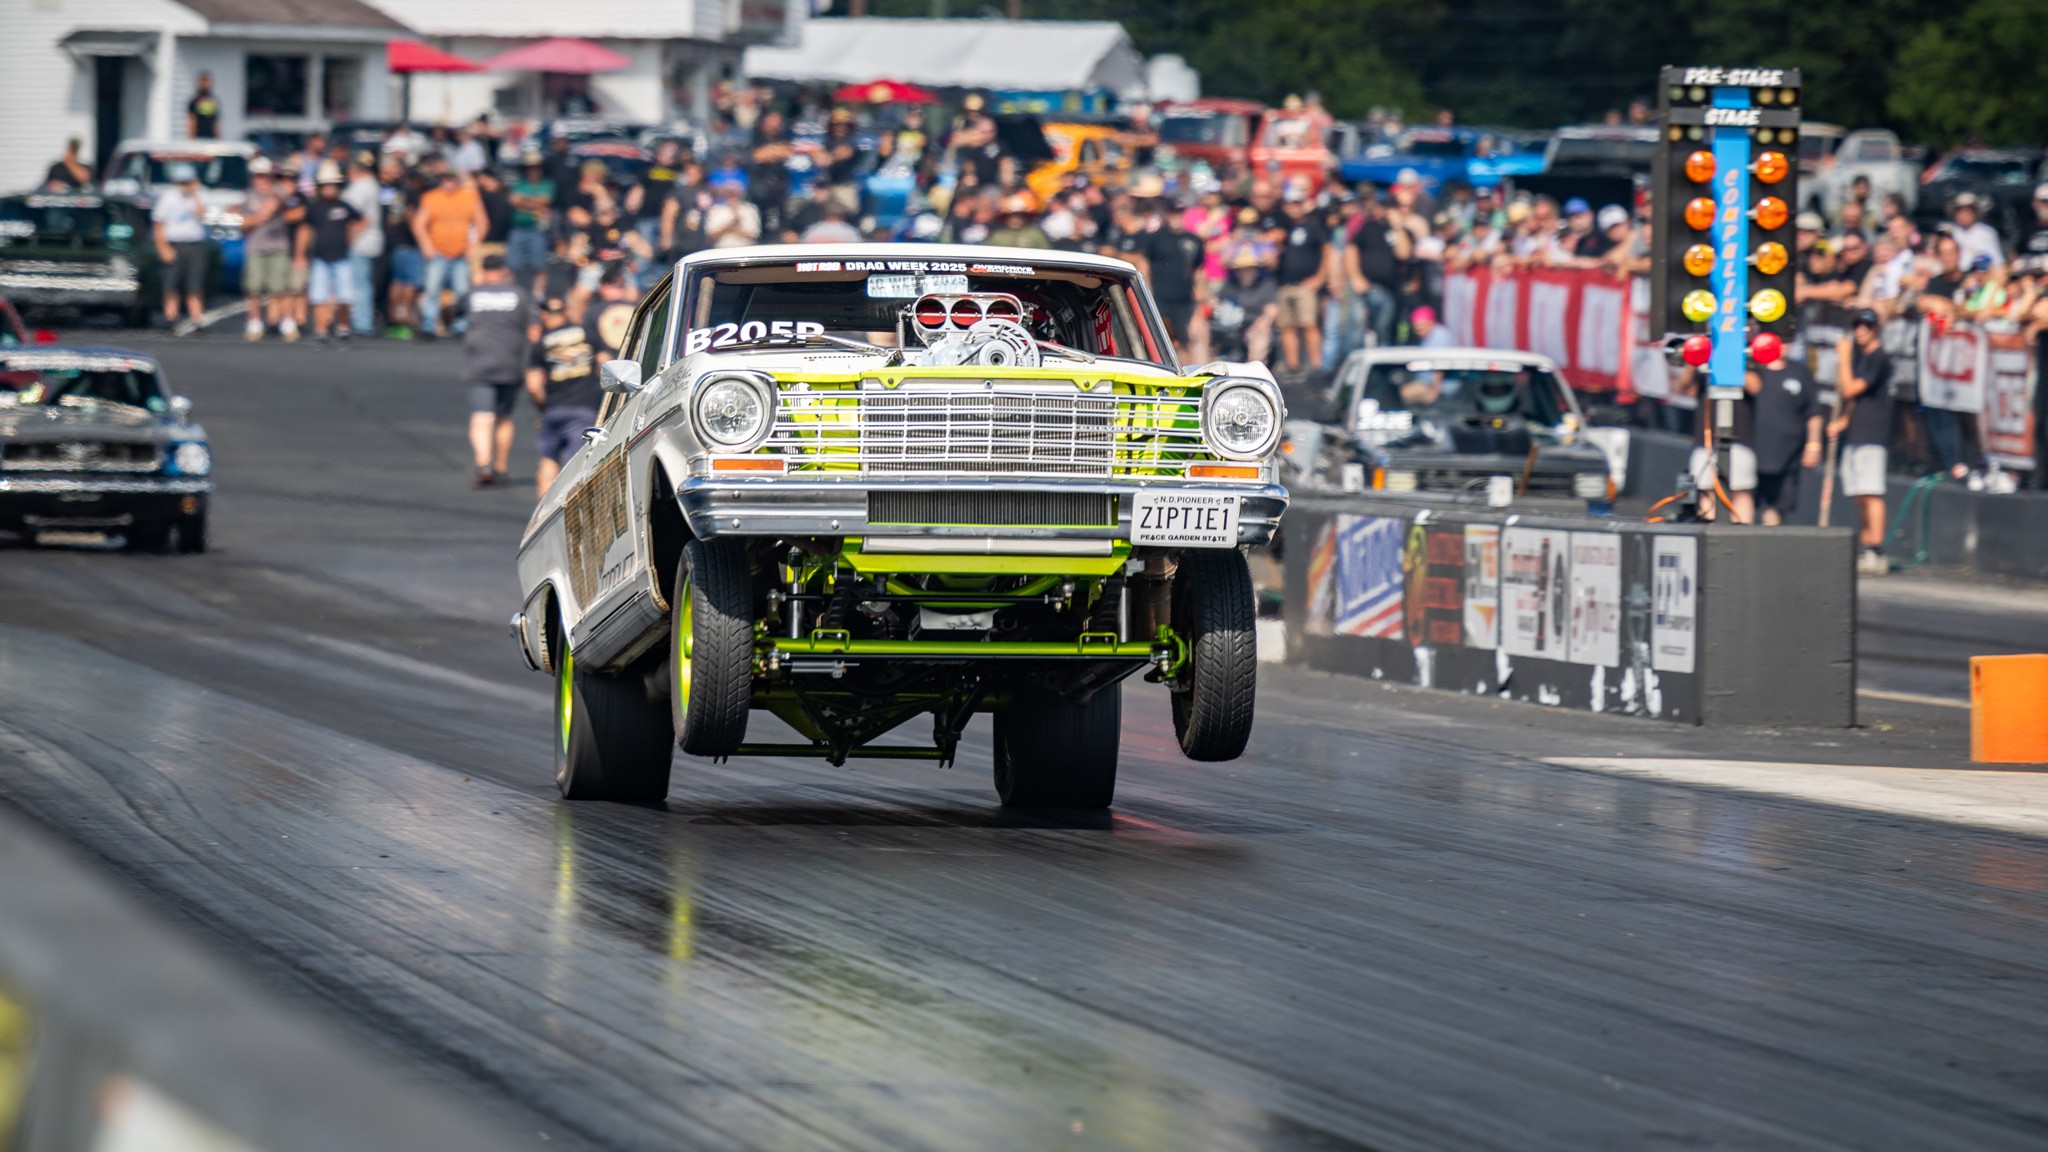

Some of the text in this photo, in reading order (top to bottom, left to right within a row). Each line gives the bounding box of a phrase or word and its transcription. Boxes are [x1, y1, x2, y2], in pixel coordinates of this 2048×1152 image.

[1684, 67, 1784, 87] PRE-STAGE
[1704, 108, 1762, 127] STAGE
[845, 261, 968, 272] DRAG WEEK 2025
[1140, 506, 1229, 531] ZIPTIE1
